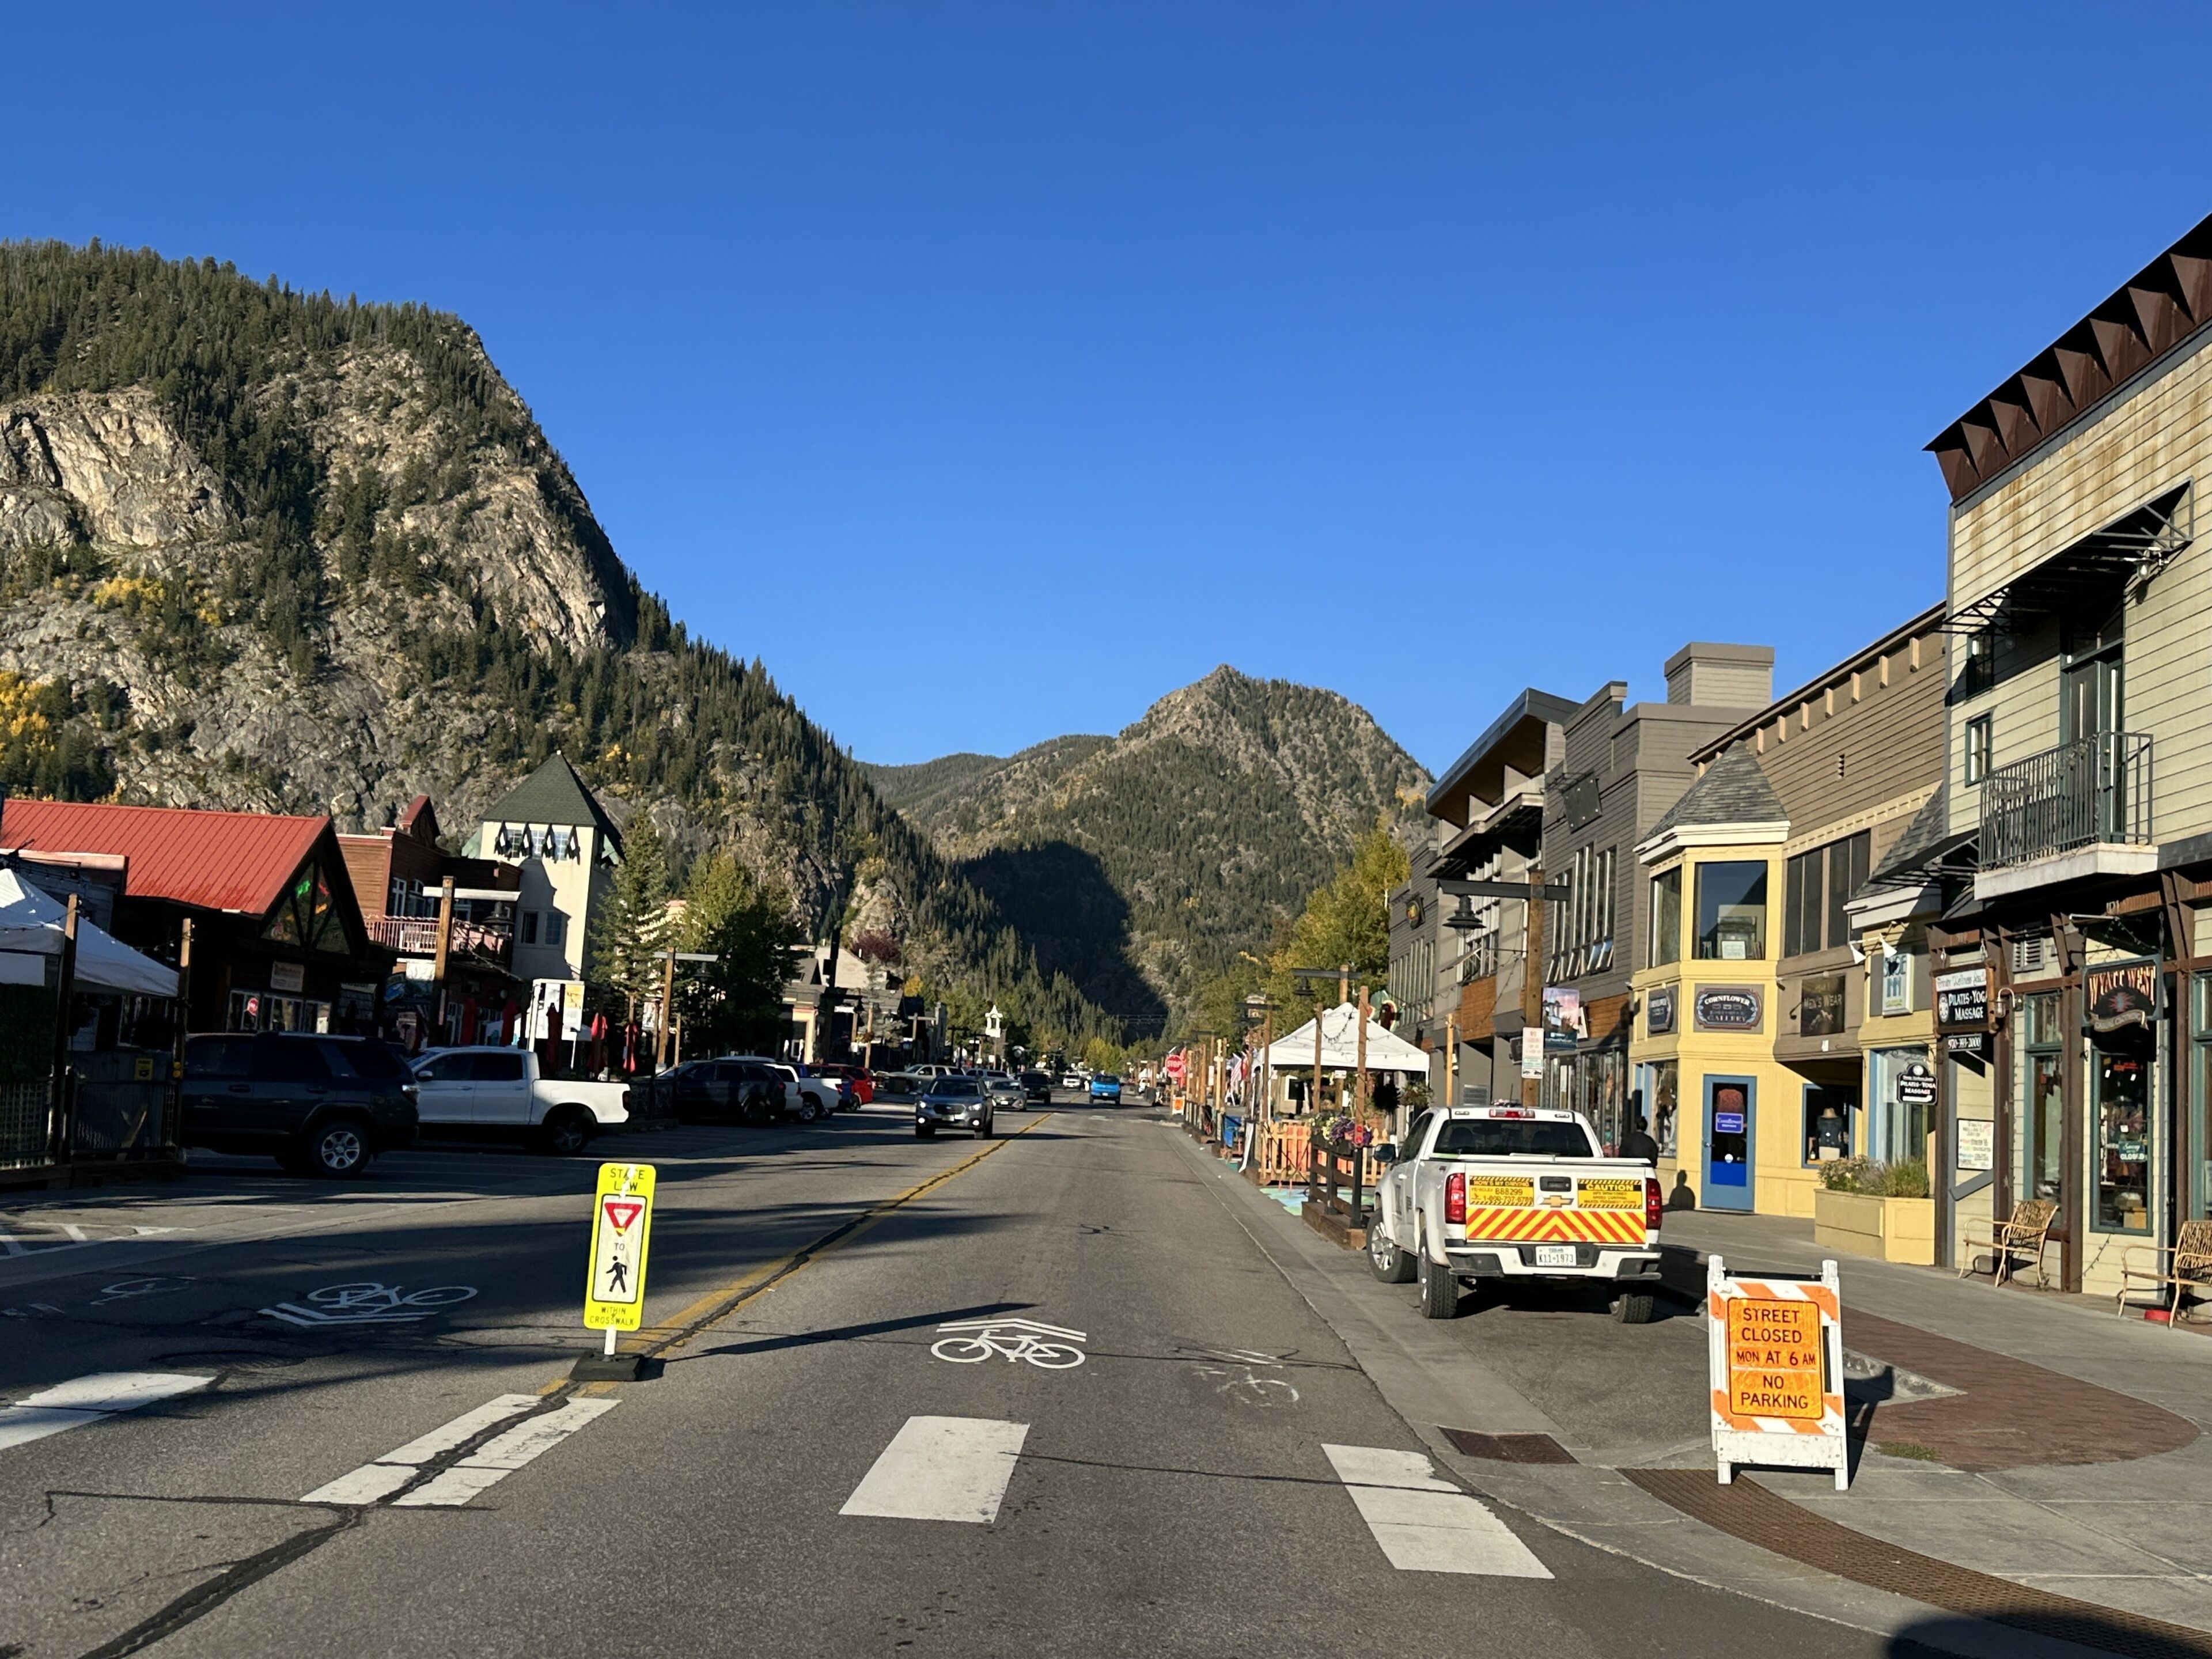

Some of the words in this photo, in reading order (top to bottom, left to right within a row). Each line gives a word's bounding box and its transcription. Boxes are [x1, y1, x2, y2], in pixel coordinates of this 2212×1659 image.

[2127, 965, 2156, 1006] WEST
[1704, 995, 1750, 1006] CORNFLOWER
[1948, 993, 1969, 1006] PILATES
[1955, 1006, 1983, 1021] MASSAGE
[1167, 1060, 1181, 1068] STOP
[610, 1167, 645, 1180] STAE
[613, 1181, 638, 1192] LW
[614, 1243, 625, 1251] TO
[601, 1306, 626, 1315] WITHIN
[1743, 1308, 1800, 1324] STREET
[589, 1316, 634, 1326] CROSSWALK
[1741, 1327, 1802, 1343] CLOSED
[1737, 1350, 1759, 1363] MON
[1766, 1351, 1781, 1363] AT
[1789, 1351, 1798, 1366] 6
[1802, 1353, 1816, 1365] AM
[1763, 1375, 1784, 1389] NO
[1741, 1392, 1808, 1409] PARKING
